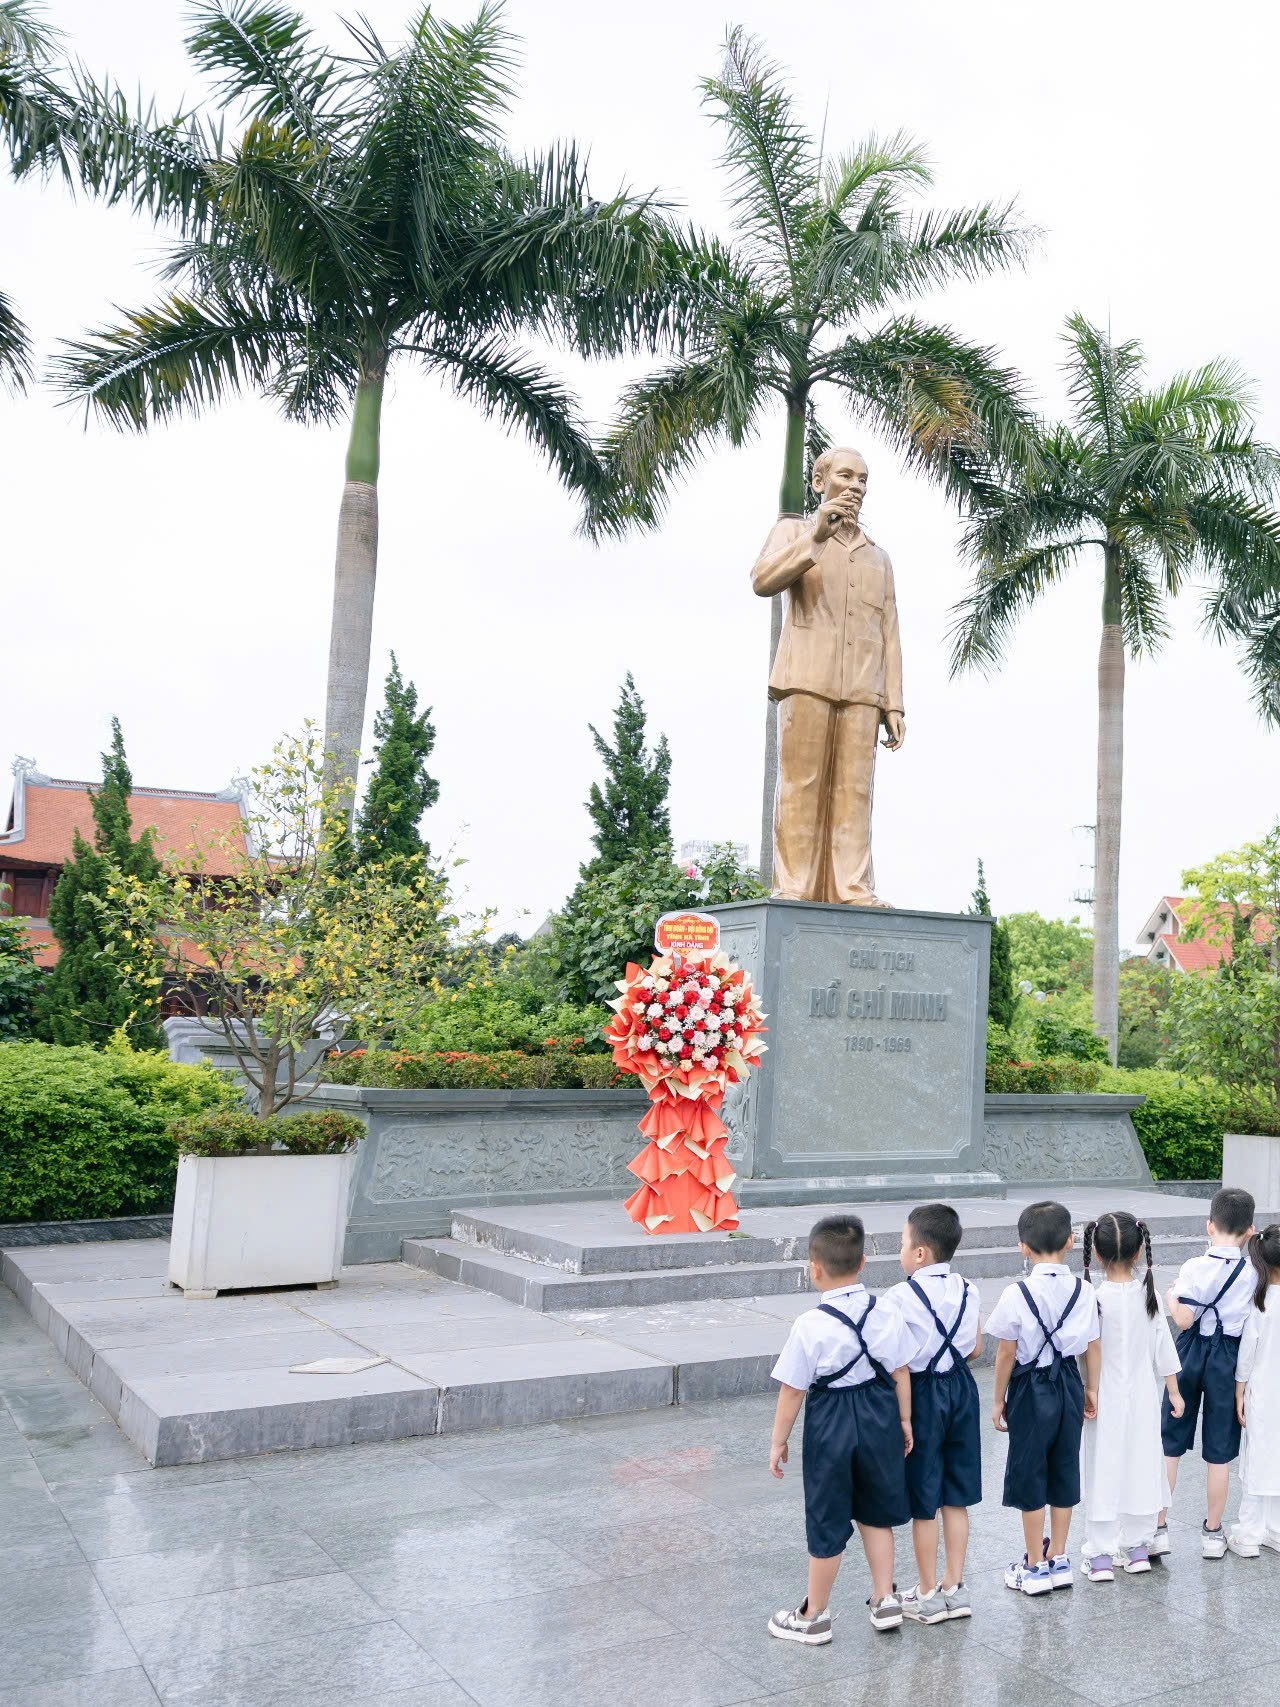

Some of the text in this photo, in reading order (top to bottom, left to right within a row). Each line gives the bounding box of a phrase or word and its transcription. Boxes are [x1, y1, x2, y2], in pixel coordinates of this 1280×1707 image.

[670, 940, 685, 948] KÍNH
[849, 942, 915, 976] CHỦ TỊCH
[847, 983, 886, 1020] CHÍ
[889, 989, 949, 1022] MINH
[844, 1034, 874, 1052] 1890
[882, 1035, 912, 1053] 1969
